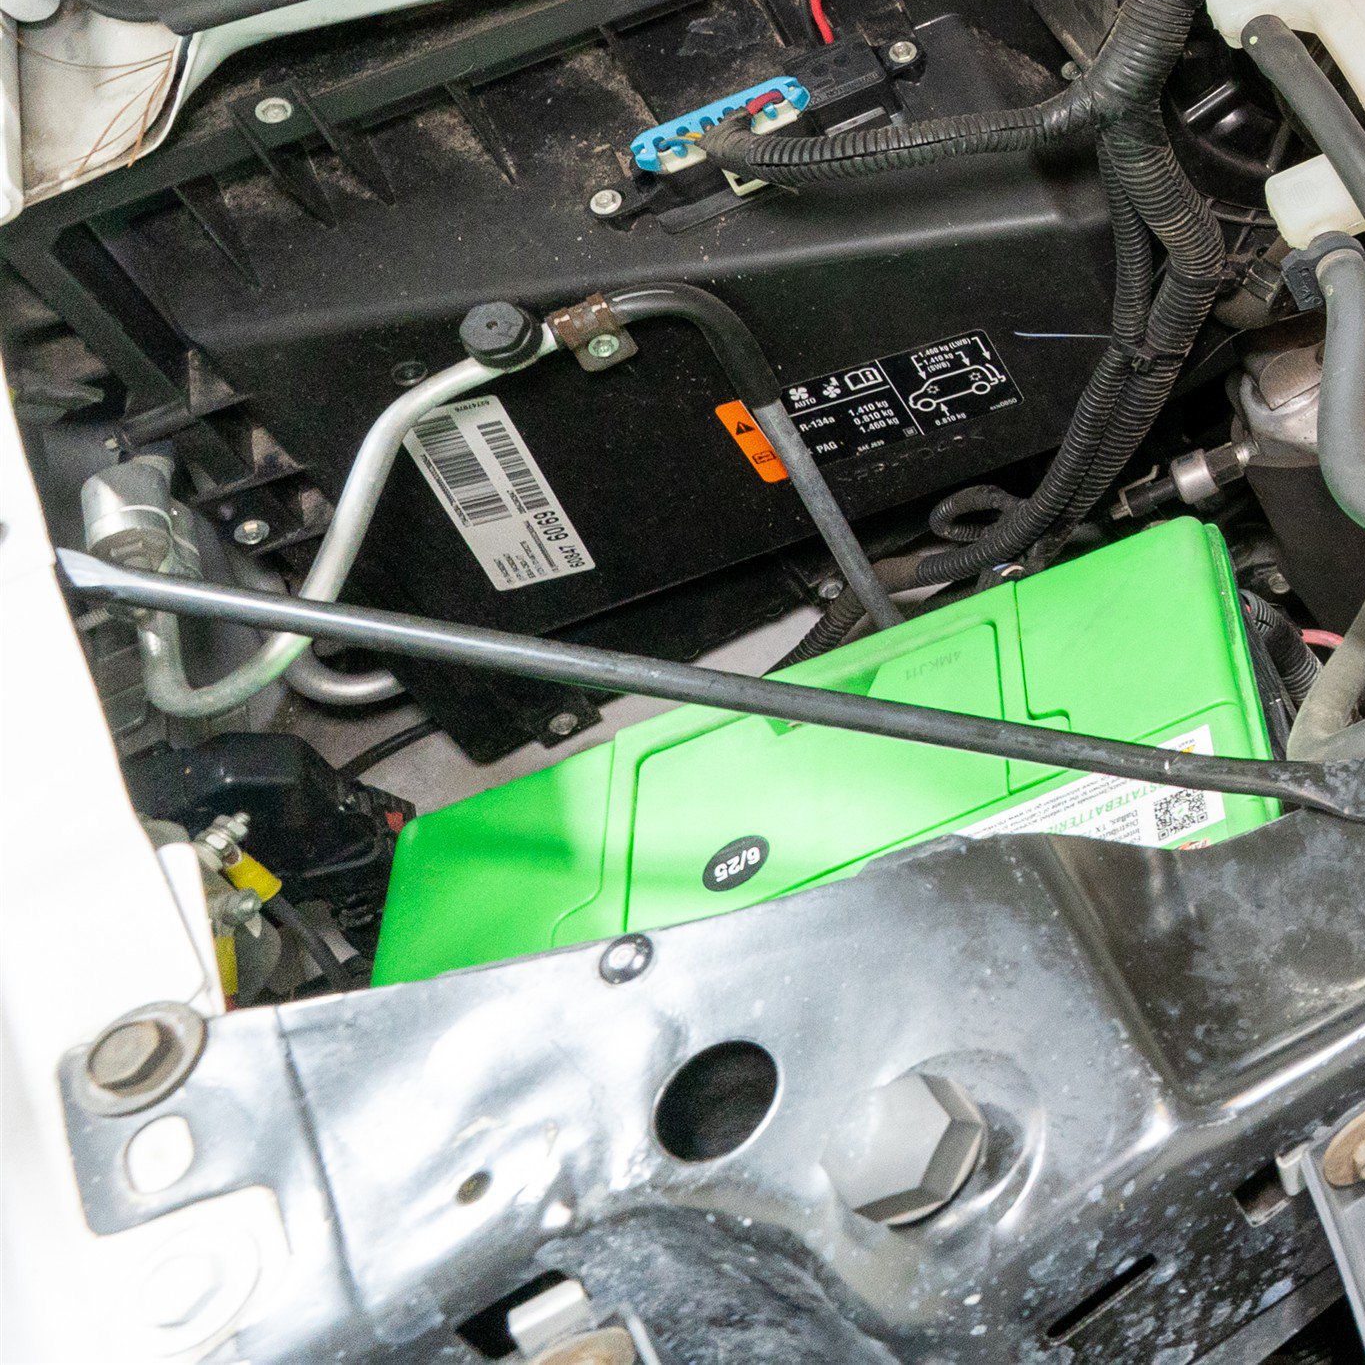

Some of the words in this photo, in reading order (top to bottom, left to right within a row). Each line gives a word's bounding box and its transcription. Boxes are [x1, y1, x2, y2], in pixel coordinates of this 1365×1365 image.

[918, 347, 938, 357] 1.460
[949, 338, 971, 349] (LWB)
[923, 355, 943, 365] 1.410
[927, 361, 950, 372] (SWB)
[795, 398, 816, 408] AUTO
[799, 417, 835, 431] R-134a
[848, 403, 875, 416] 1.410
[875, 400, 888, 408] kg
[854, 412, 880, 425] 0.810
[881, 409, 894, 417] kg
[935, 415, 956, 426] 0.810
[860, 420, 886, 433] 1.460
[886, 417, 899, 425] kg
[816, 441, 838, 453] PAG
[533, 510, 569, 541] 60/69
[559, 545, 585, 568] 60847
[714, 846, 761, 882] 6/25
